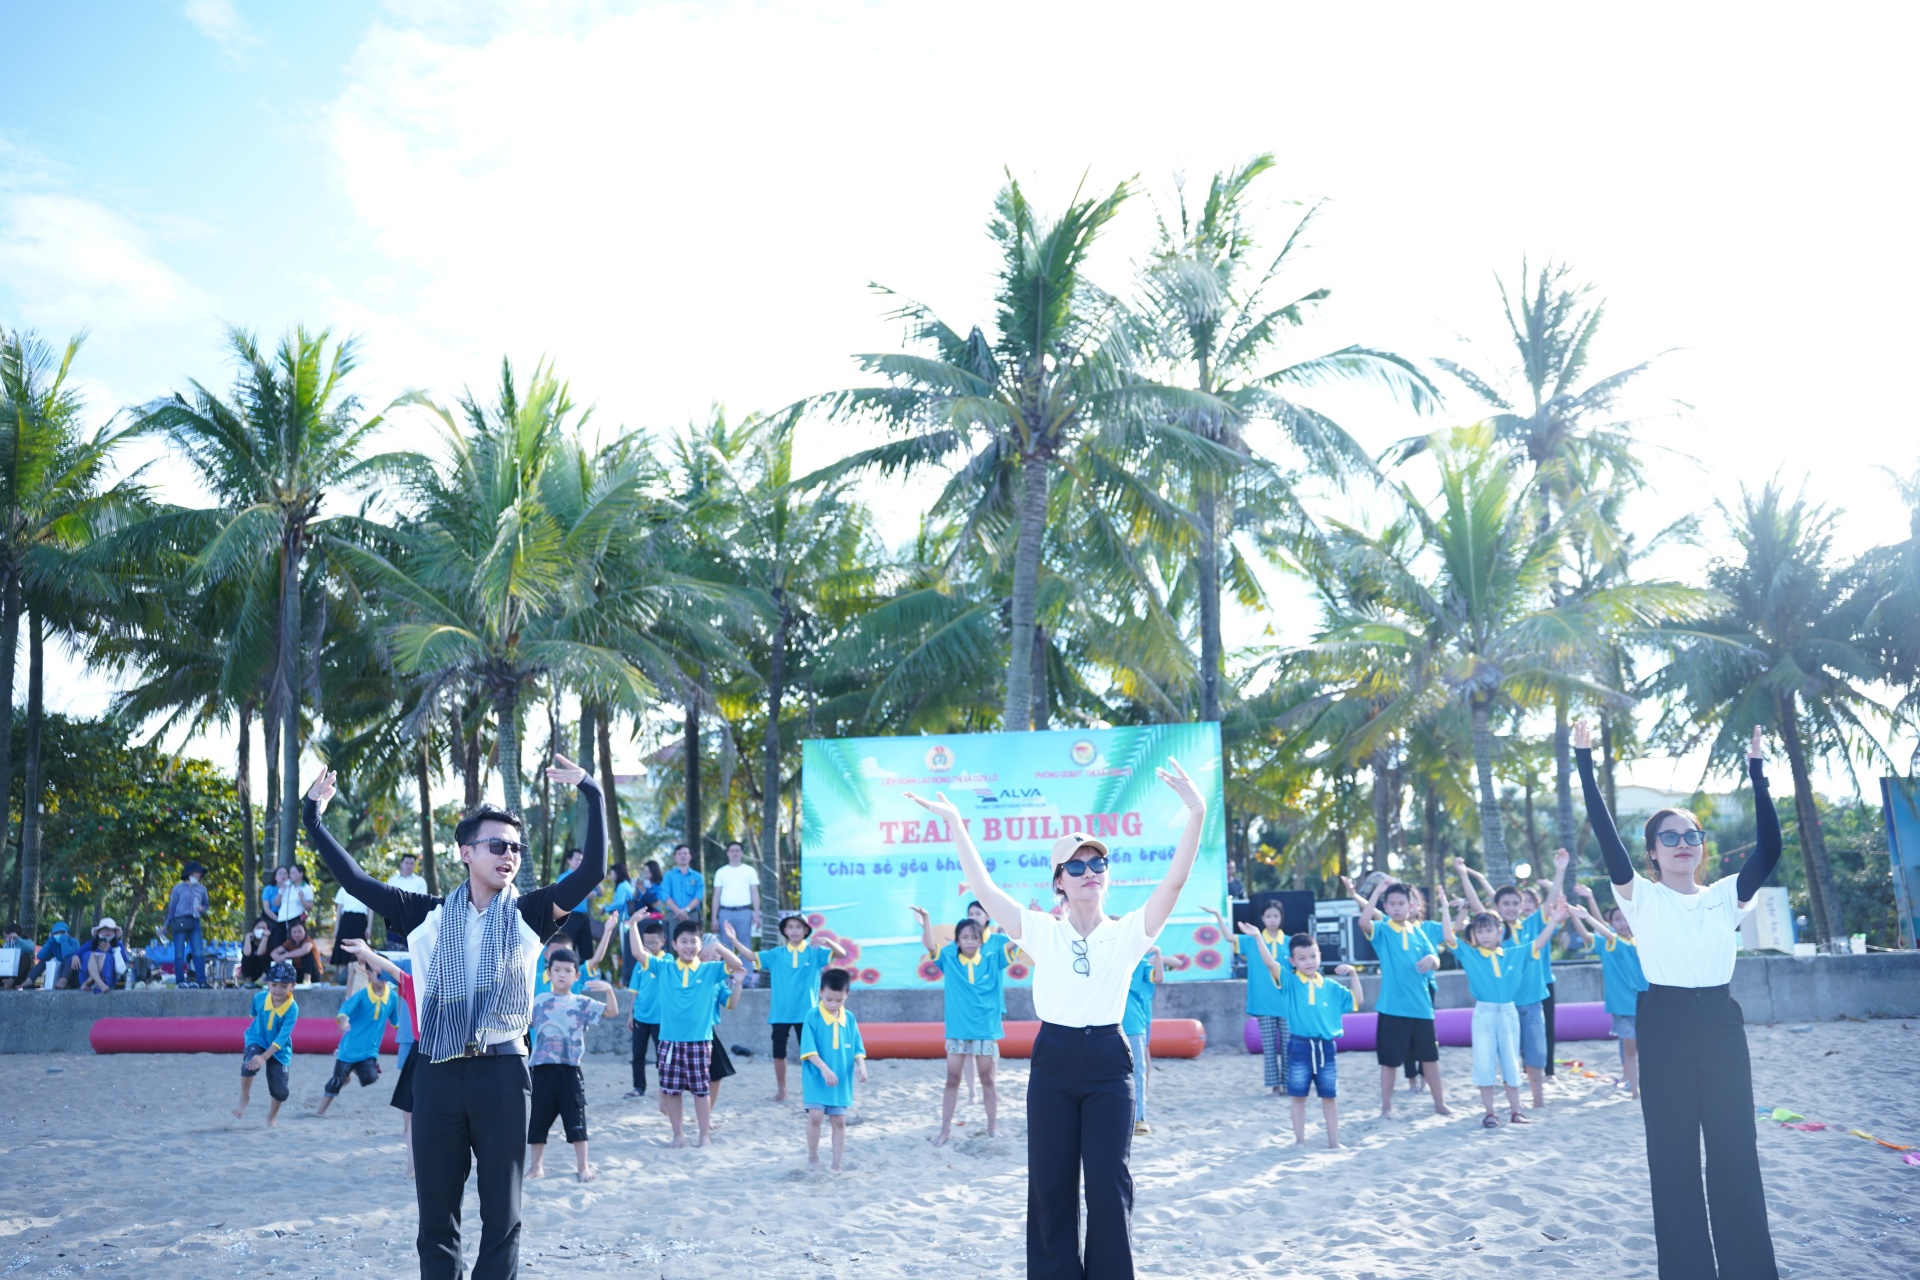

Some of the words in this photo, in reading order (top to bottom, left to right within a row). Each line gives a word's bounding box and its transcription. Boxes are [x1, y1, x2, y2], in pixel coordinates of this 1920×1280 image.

[999, 788, 1042, 798] ALVA
[982, 811, 1143, 842] BUILDING
[899, 858, 929, 878] yêu
[1018, 852, 1052, 870] Cùn
[1109, 846, 1132, 864] ến
